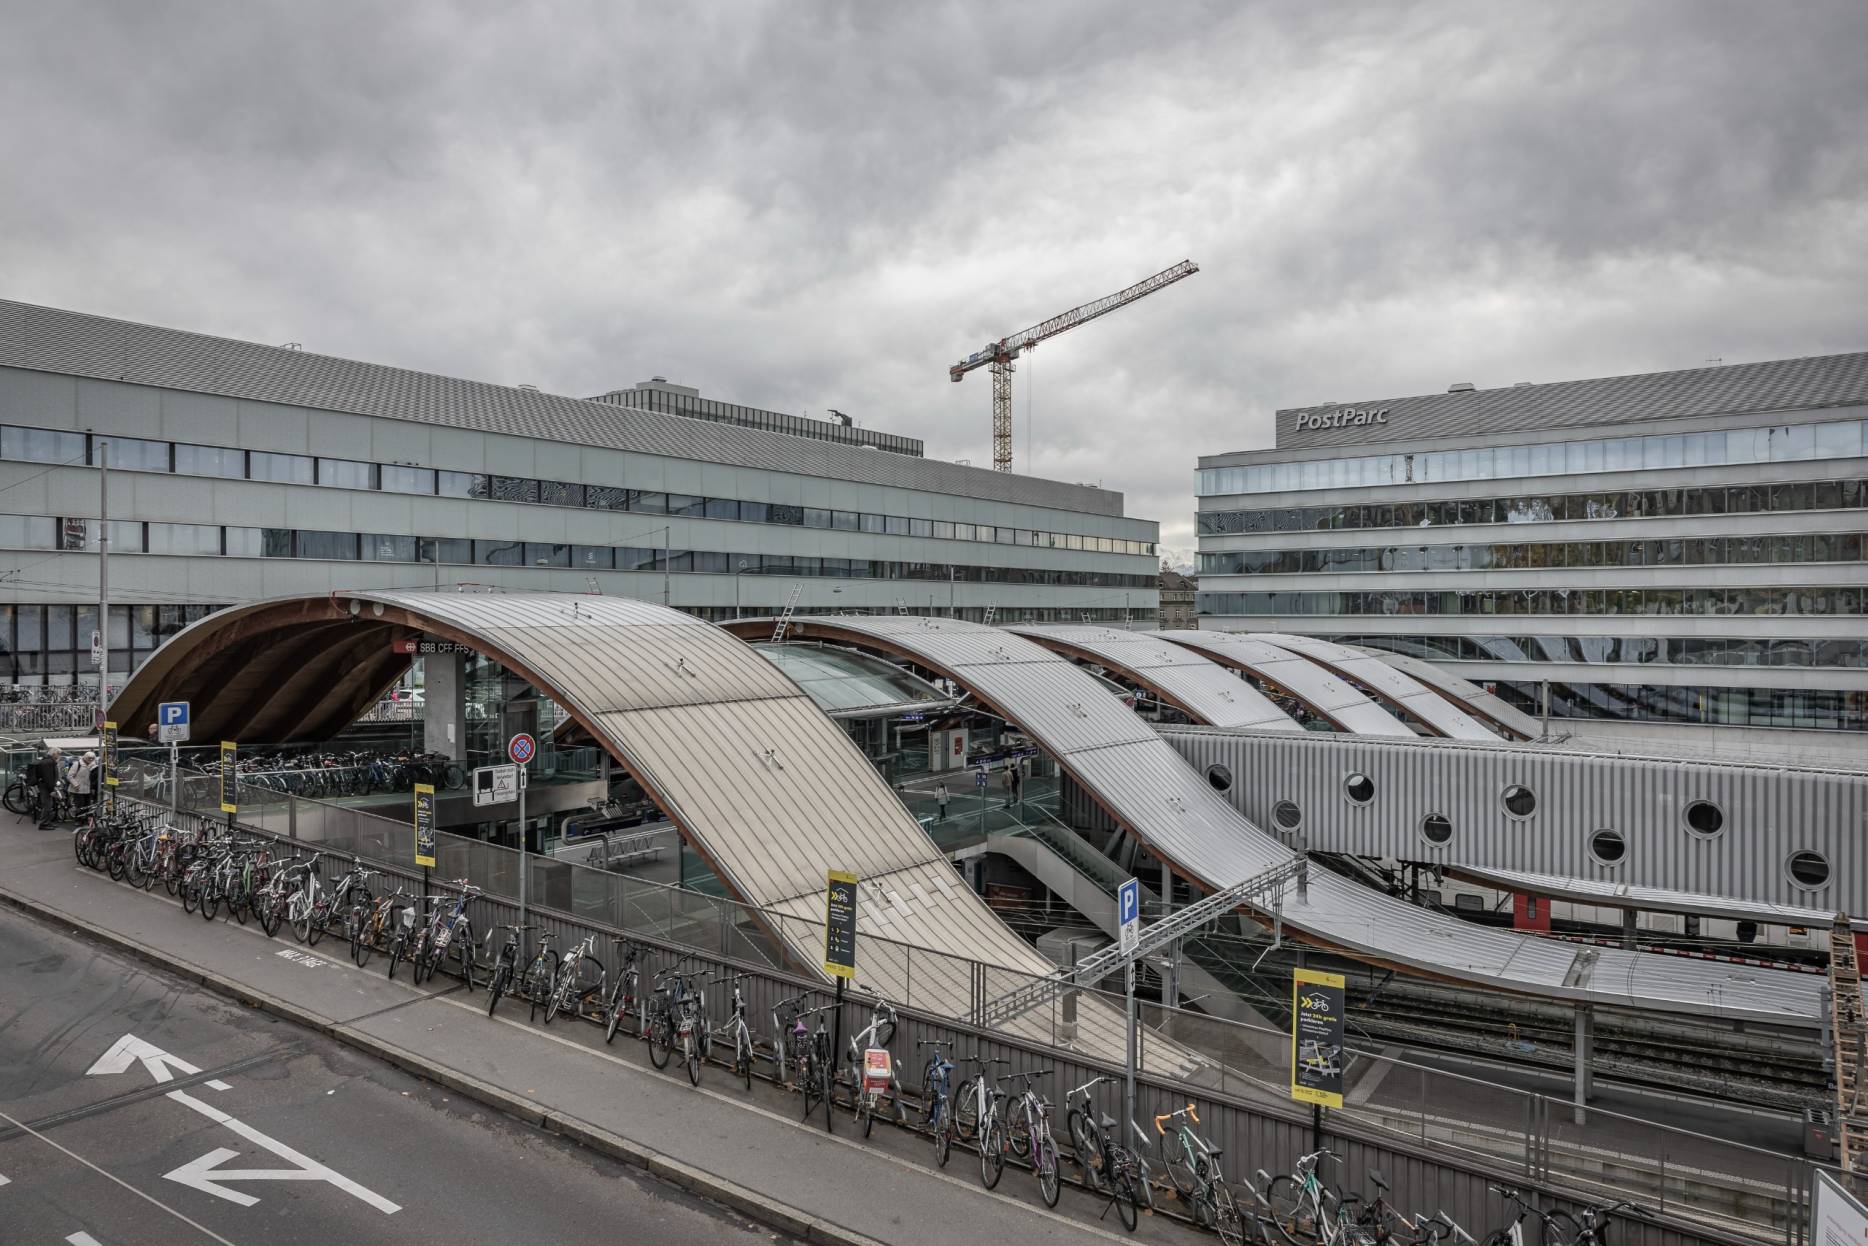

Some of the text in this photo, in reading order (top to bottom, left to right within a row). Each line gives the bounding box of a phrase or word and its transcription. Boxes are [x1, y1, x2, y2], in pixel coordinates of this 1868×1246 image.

[1295, 408, 1389, 431] PostParc
[420, 642, 470, 654] SBB CFF FFS
[167, 706, 182, 724] P
[1124, 889, 1134, 920] P
